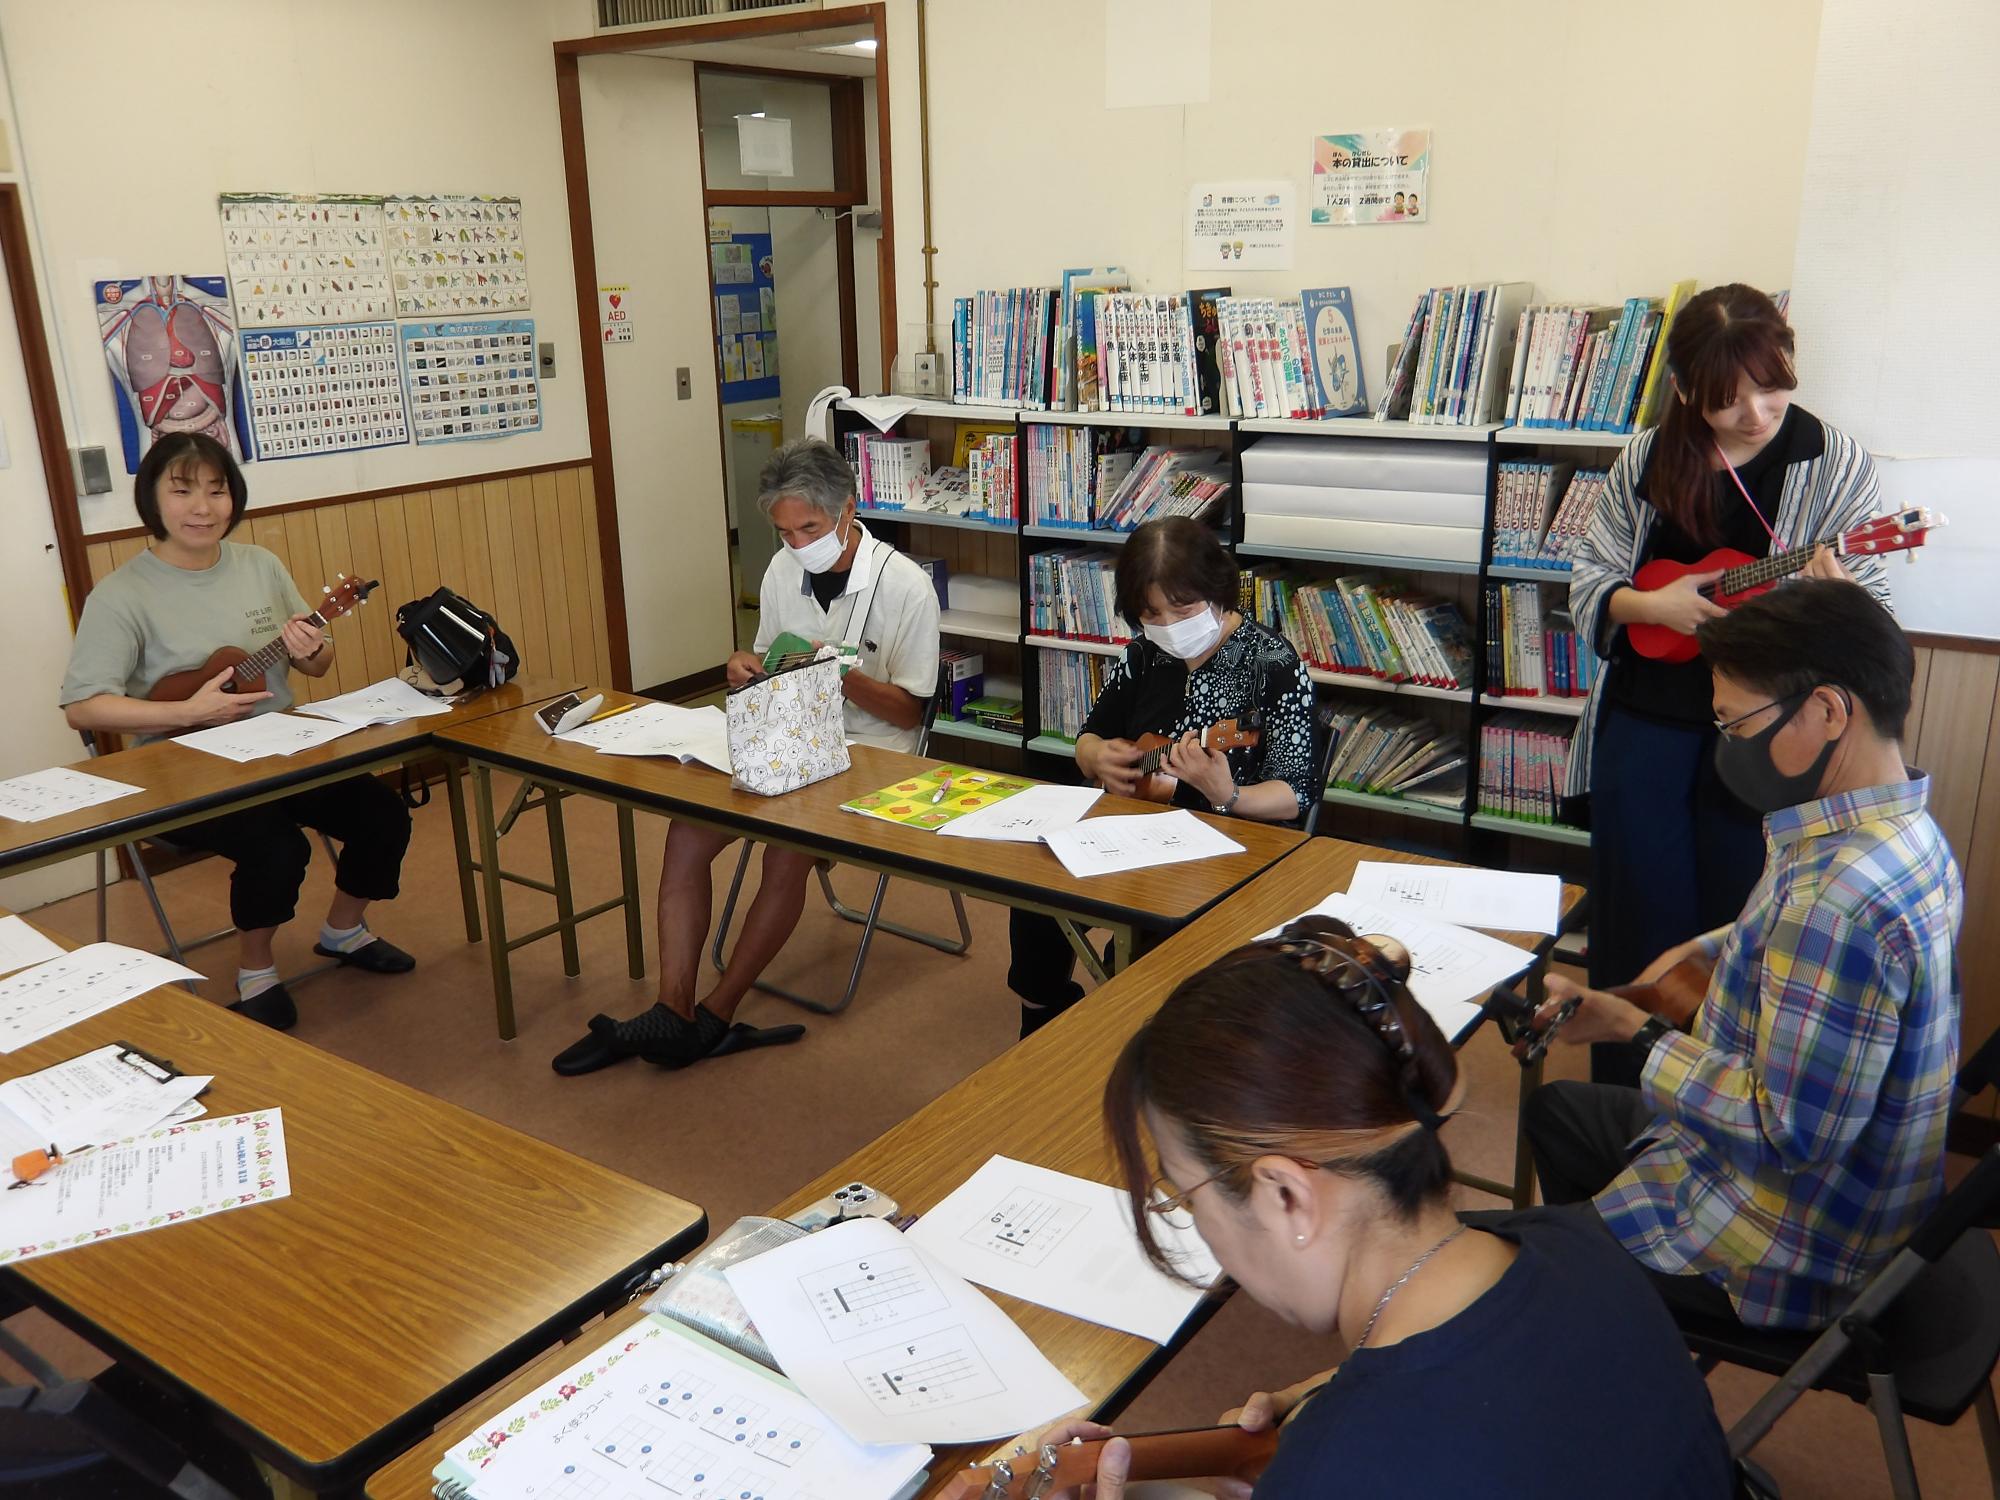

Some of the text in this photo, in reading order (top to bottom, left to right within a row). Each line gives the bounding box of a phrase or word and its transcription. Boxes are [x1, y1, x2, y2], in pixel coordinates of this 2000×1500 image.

[1332, 155, 1409, 169] 本の貸出について
[608, 310, 626, 321] AED
[1128, 341, 1138, 362] 人体
[1148, 341, 1158, 362] 昆虫
[1160, 341, 1171, 363] 鉄道
[1138, 341, 1150, 383] 危険生物
[991, 1211, 1005, 1223] G7
[858, 1262, 870, 1271] C
[906, 1345, 916, 1356] F
[553, 1390, 613, 1444] よく使うコード
